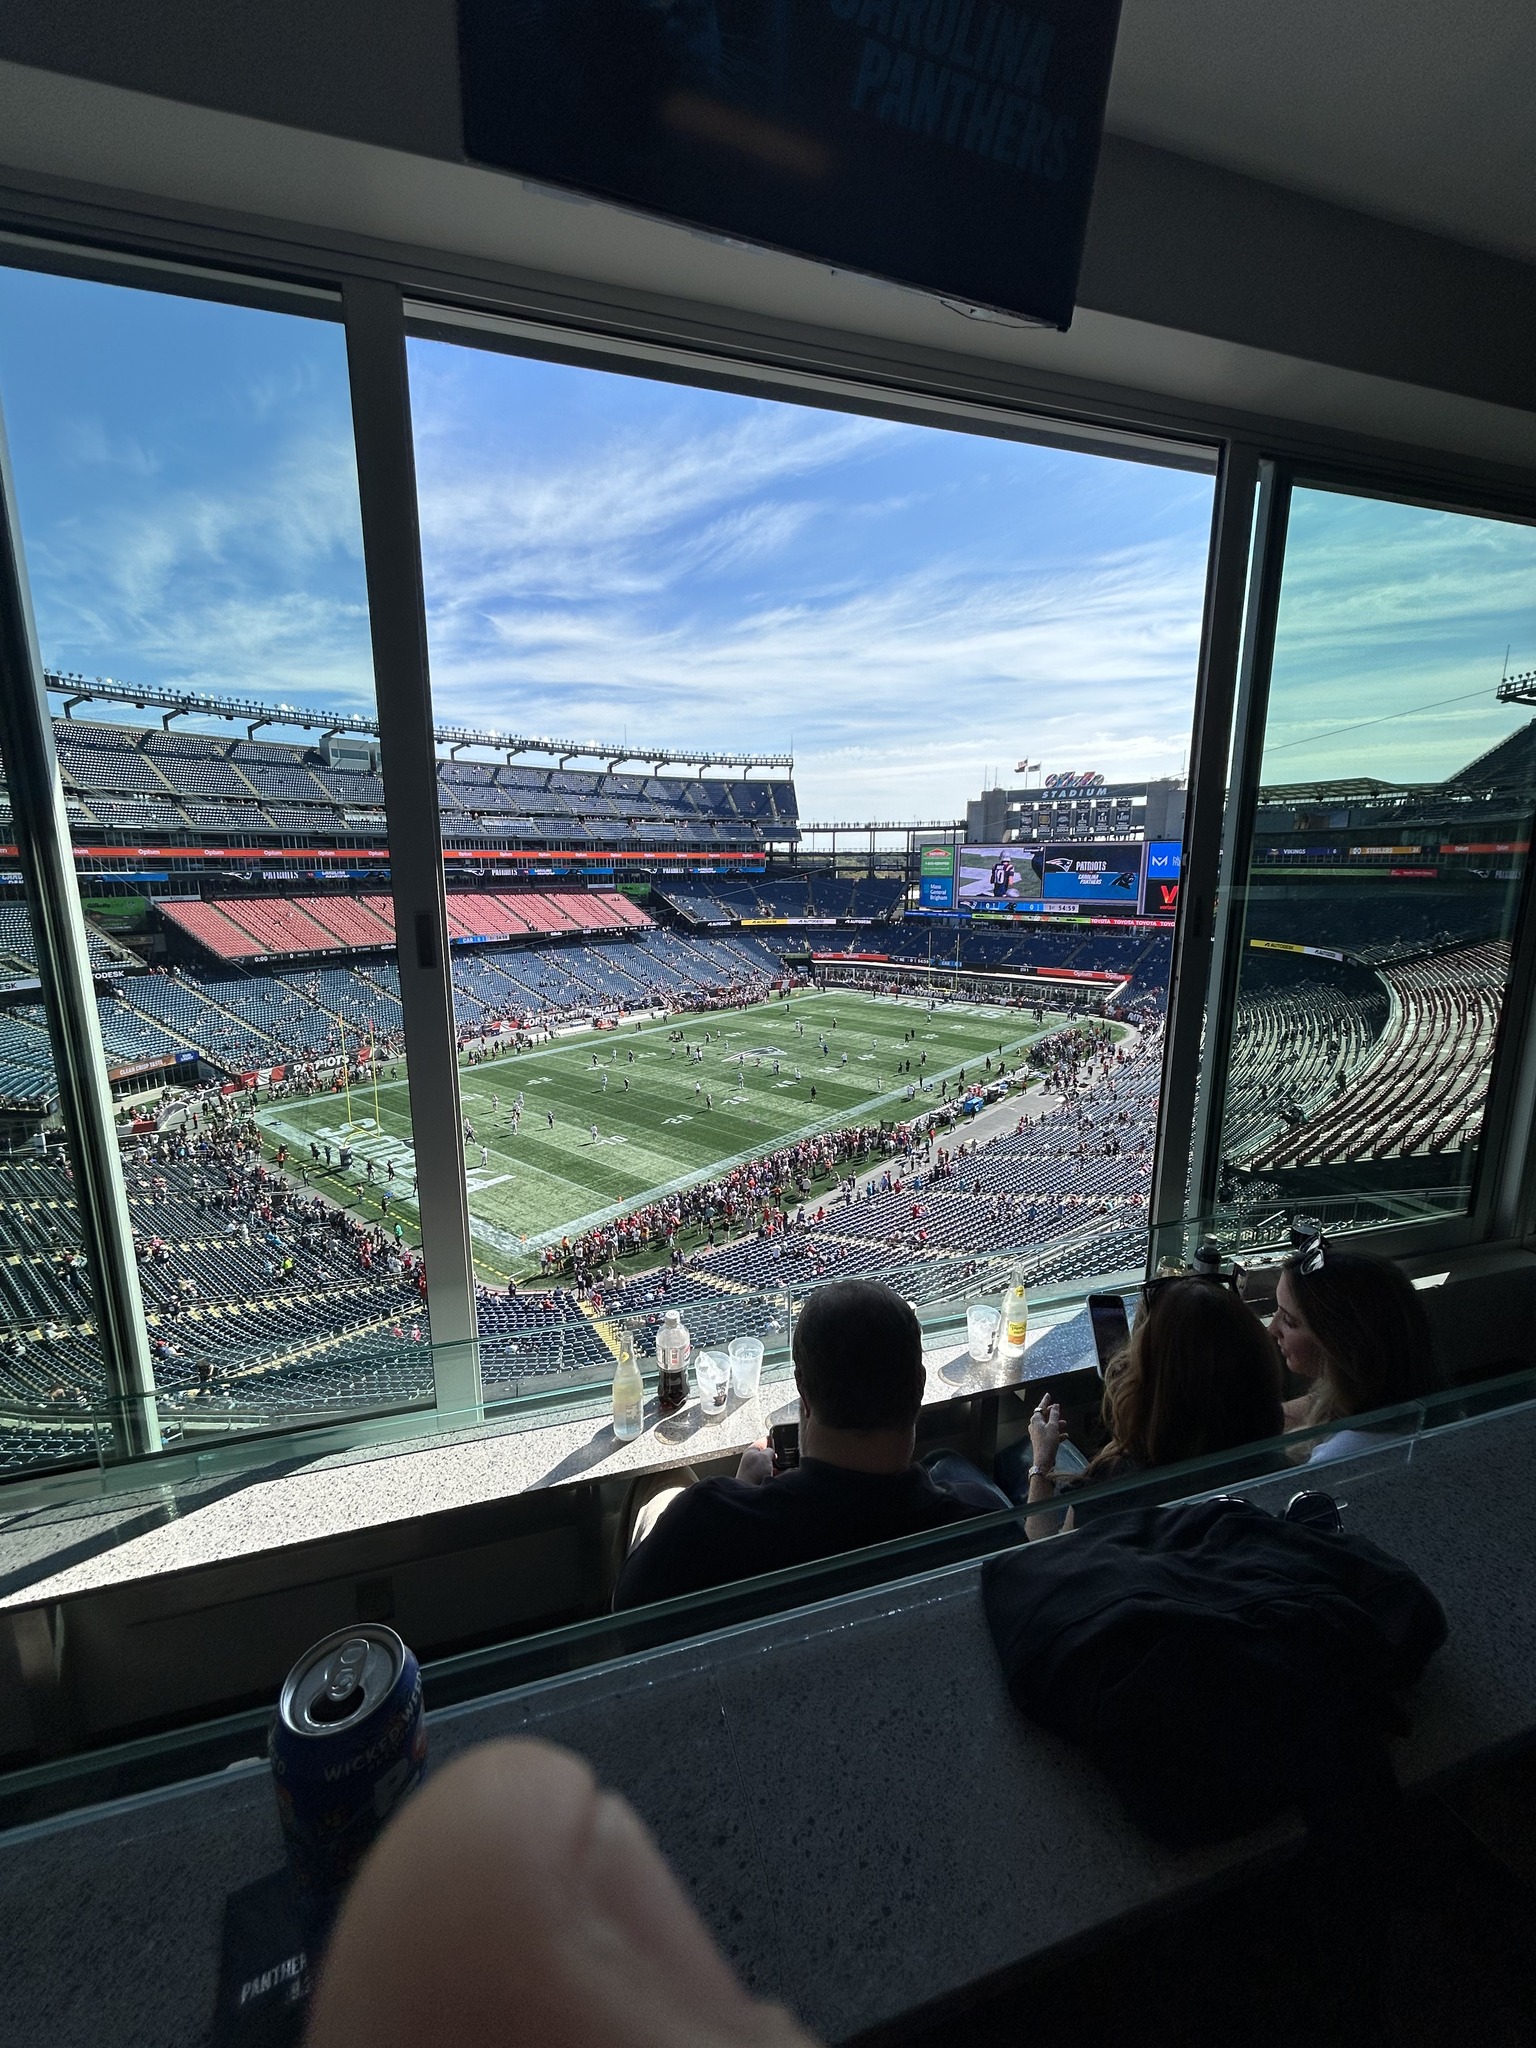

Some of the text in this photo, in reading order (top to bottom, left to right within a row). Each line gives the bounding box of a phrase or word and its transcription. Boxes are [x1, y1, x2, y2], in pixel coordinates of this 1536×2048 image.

[852, 38, 1082, 182] PANTHERS
[1042, 787, 1108, 798] STADIUM
[1076, 861, 1107, 871] PATRIOTS
[120, 1066, 136, 1076] CLEAN
[136, 1062, 150, 1072] CRISP
[660, 1114, 694, 1126] 20
[596, 1135, 629, 1146] 10
[324, 1724, 401, 1784] WICKED
[240, 1951, 308, 2006] PANTHER
